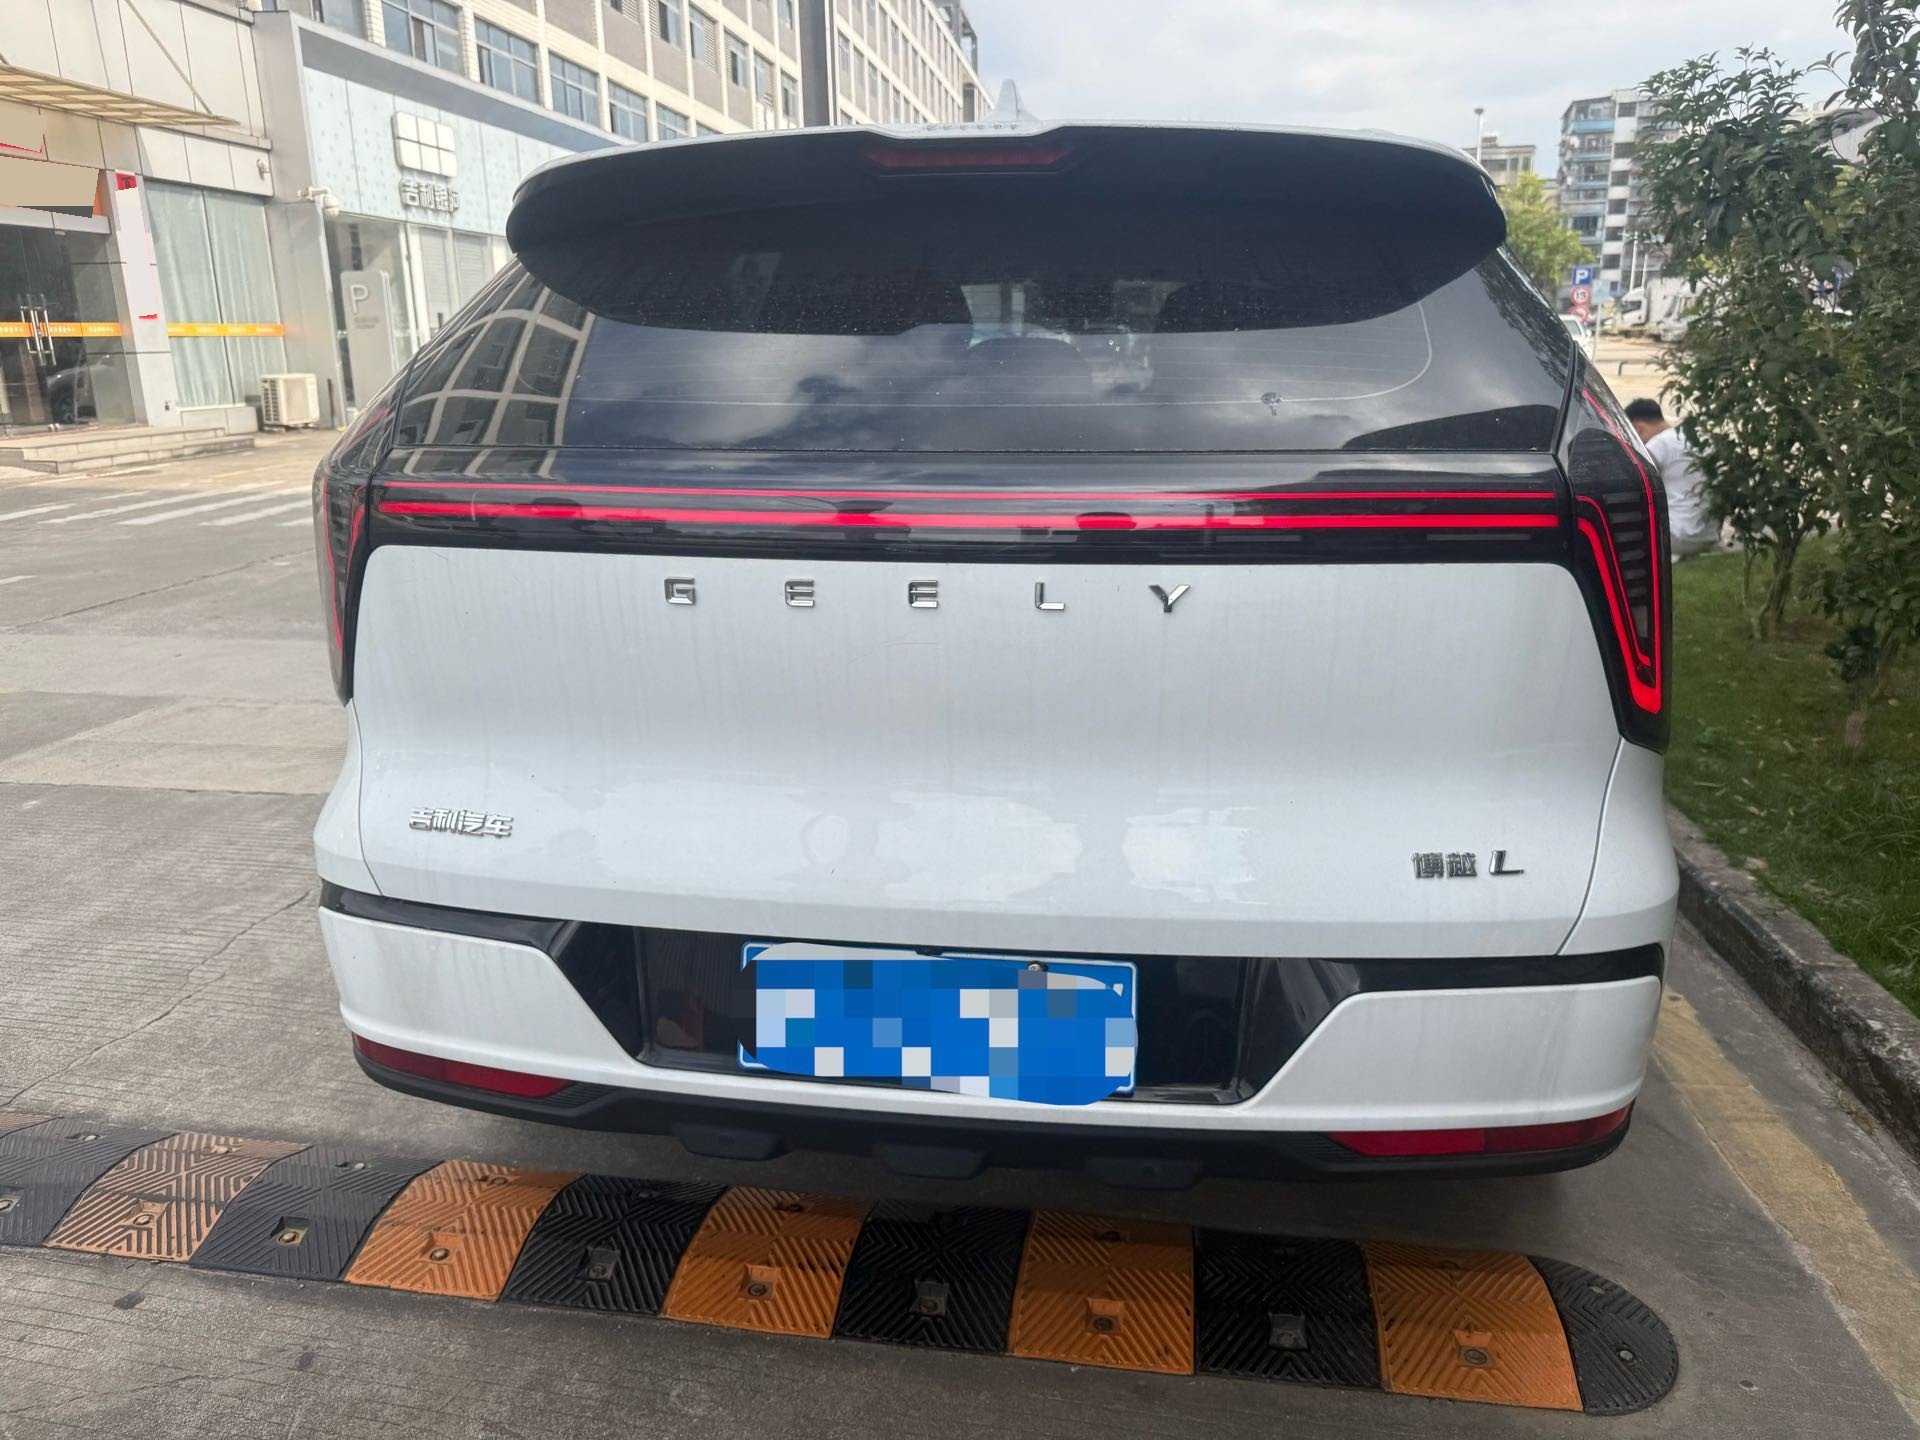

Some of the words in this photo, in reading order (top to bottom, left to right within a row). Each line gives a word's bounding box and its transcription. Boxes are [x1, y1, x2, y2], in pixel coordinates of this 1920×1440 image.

[1575, 269, 1589, 285] P
[350, 284, 369, 314] P
[664, 577, 1191, 613] GEELY
[409, 807, 514, 838] 吉利汽车
[1411, 851, 1477, 879] 博越
[1489, 849, 1525, 875] L
